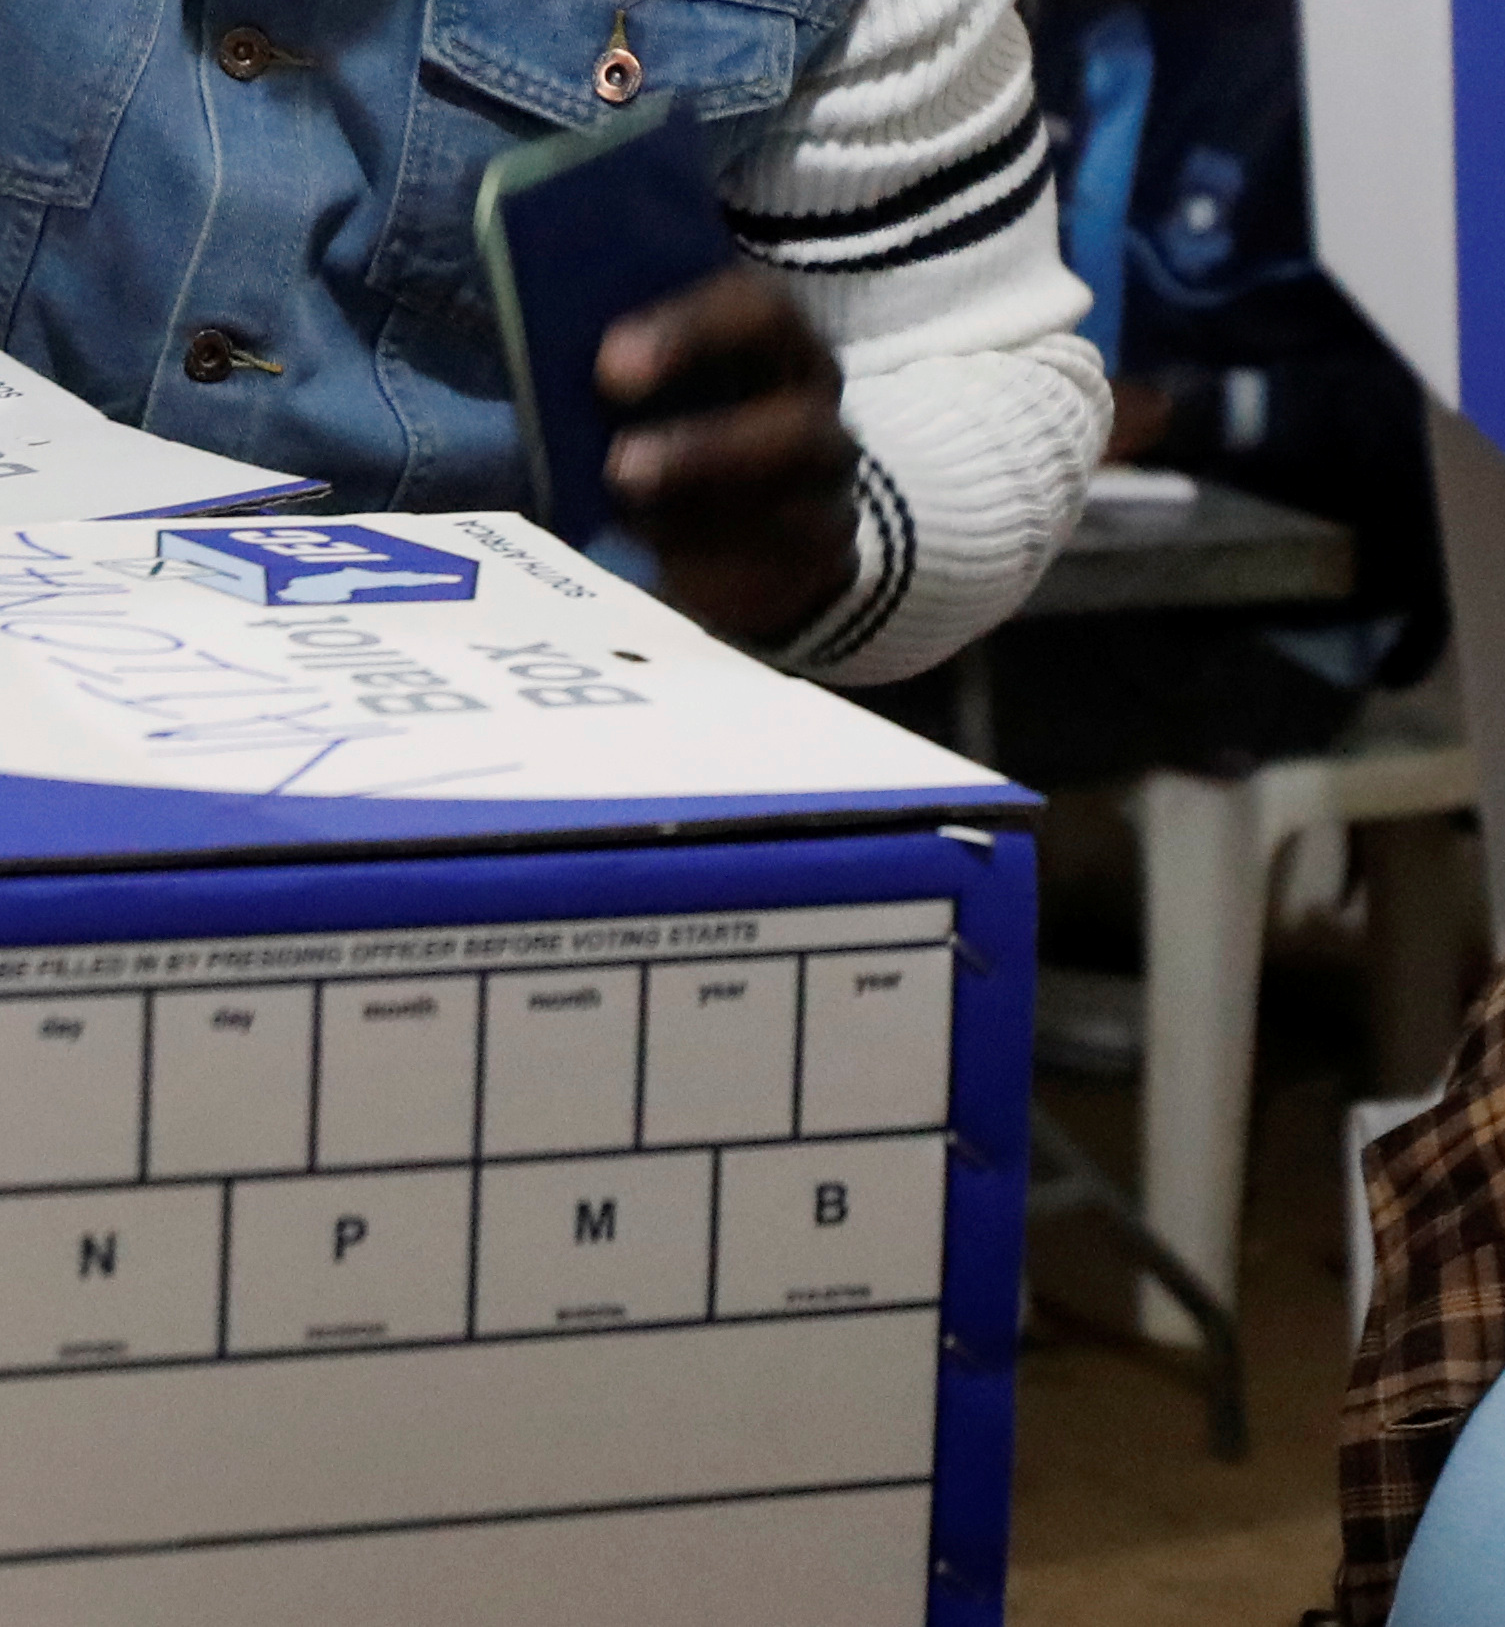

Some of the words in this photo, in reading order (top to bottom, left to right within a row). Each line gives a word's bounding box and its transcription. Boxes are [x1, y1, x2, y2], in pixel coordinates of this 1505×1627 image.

[228, 529, 391, 564] IEC
[247, 615, 492, 716] Ballot
[467, 641, 652, 708] Box
[574, 1198, 618, 1246] M
[814, 1182, 850, 1227] B
[78, 1231, 118, 1278] N
[334, 1215, 369, 1264] P
